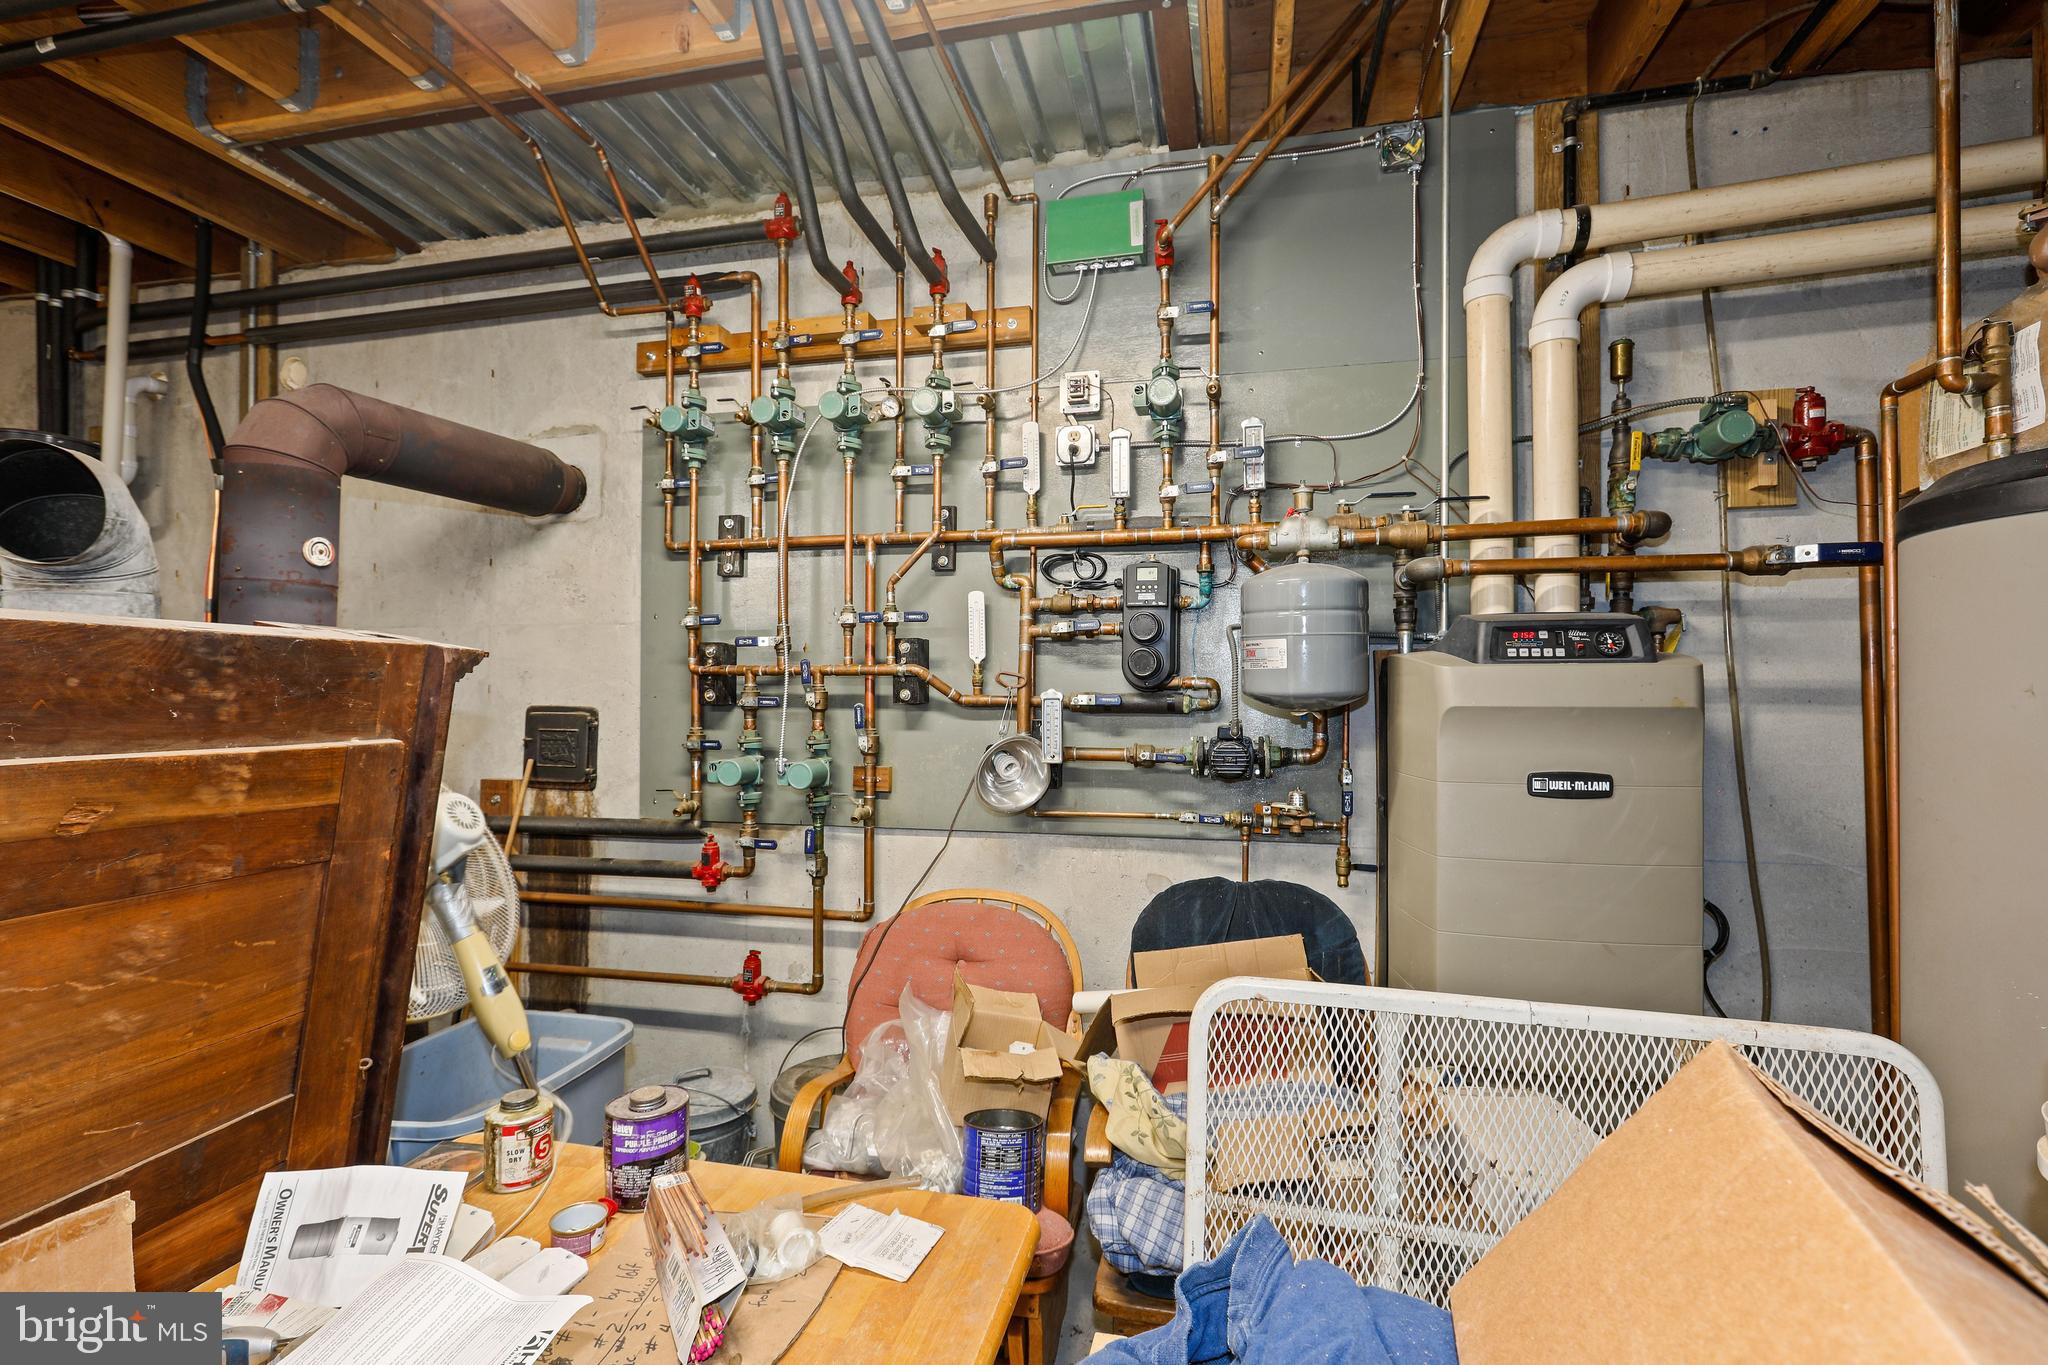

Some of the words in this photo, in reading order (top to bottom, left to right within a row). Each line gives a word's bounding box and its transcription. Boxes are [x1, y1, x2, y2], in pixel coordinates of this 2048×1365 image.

[1512, 631, 1536, 639] 0152
[539, 1135, 550, 1157] 5
[624, 1137, 652, 1148] PURPLE
[506, 1148, 526, 1157] SLOW
[508, 1156, 523, 1164] DRY
